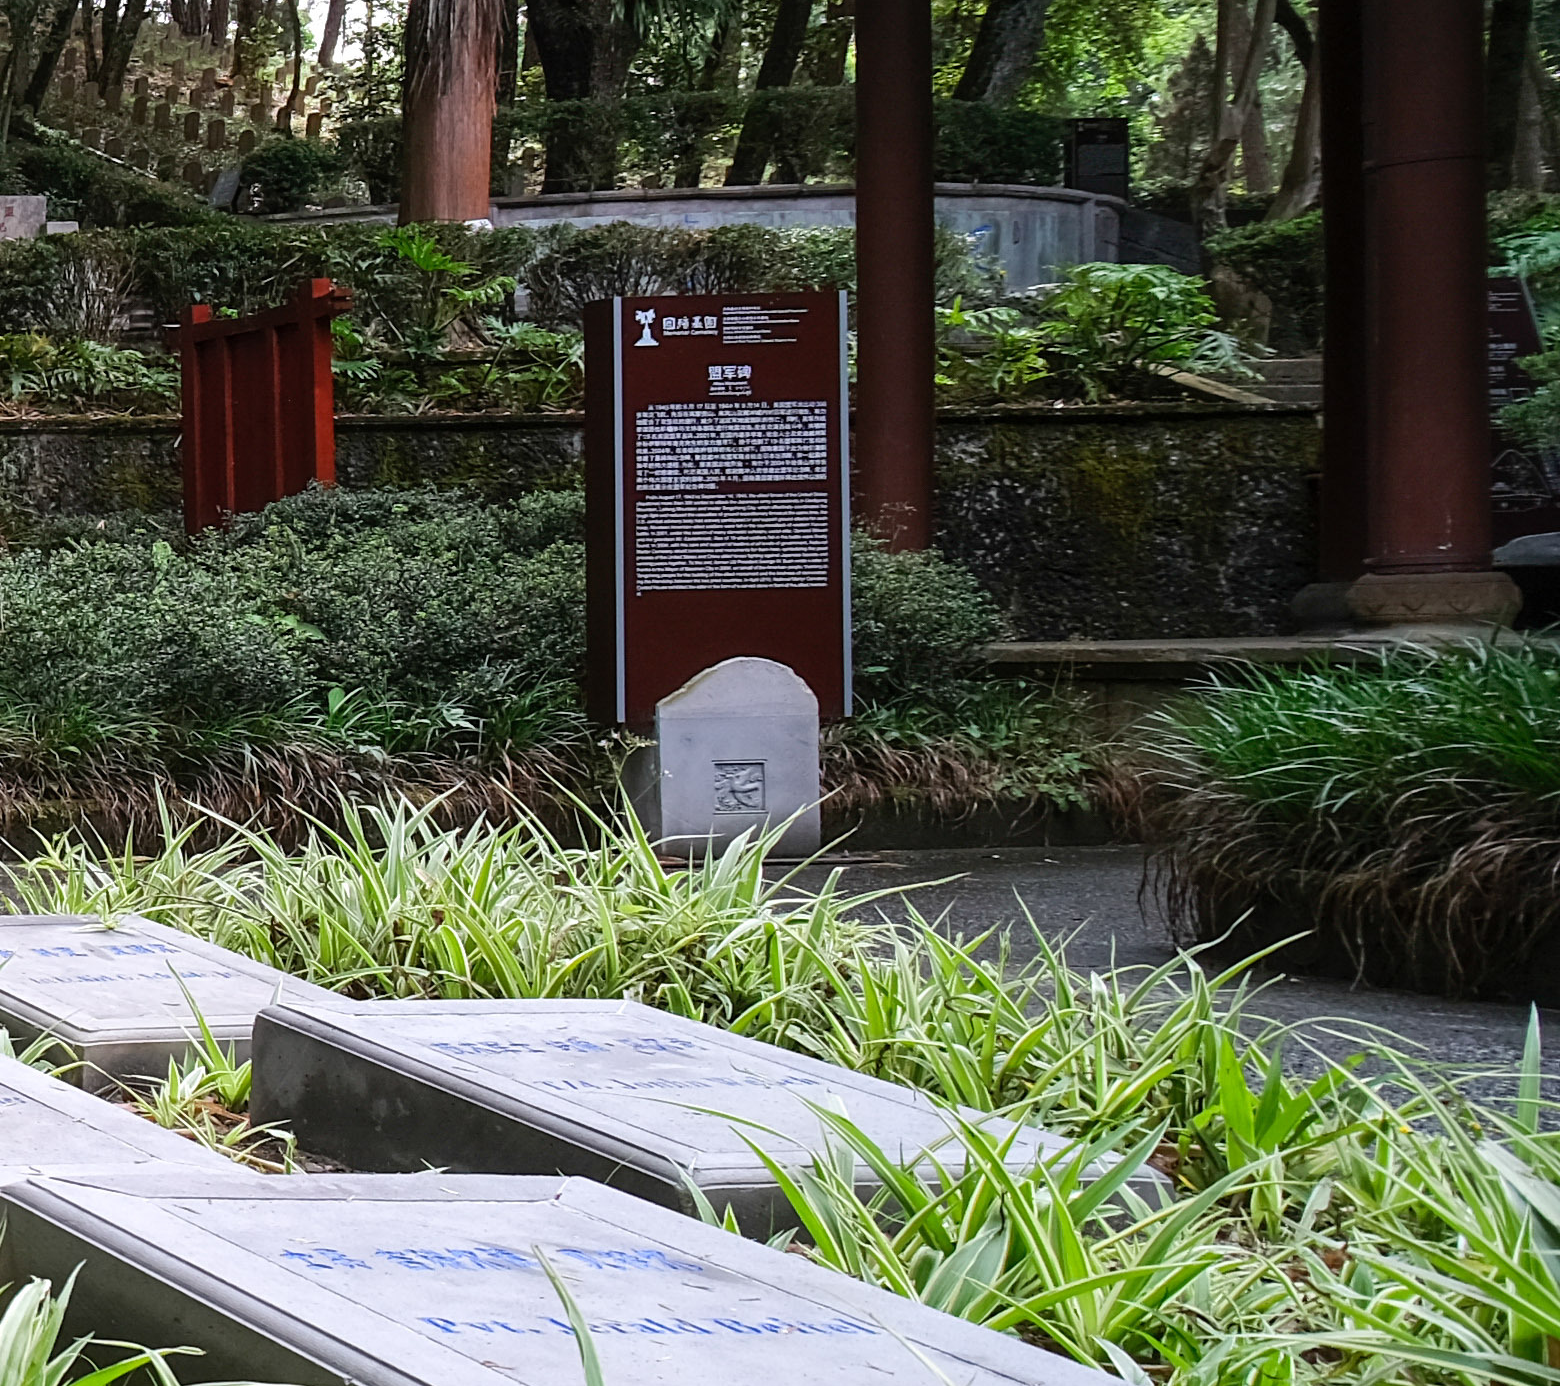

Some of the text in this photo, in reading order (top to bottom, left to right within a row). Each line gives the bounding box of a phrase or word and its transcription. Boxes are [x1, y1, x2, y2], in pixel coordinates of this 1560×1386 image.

[707, 365, 752, 381] 盟军碑
[416, 1316, 542, 1336] Pvt.
